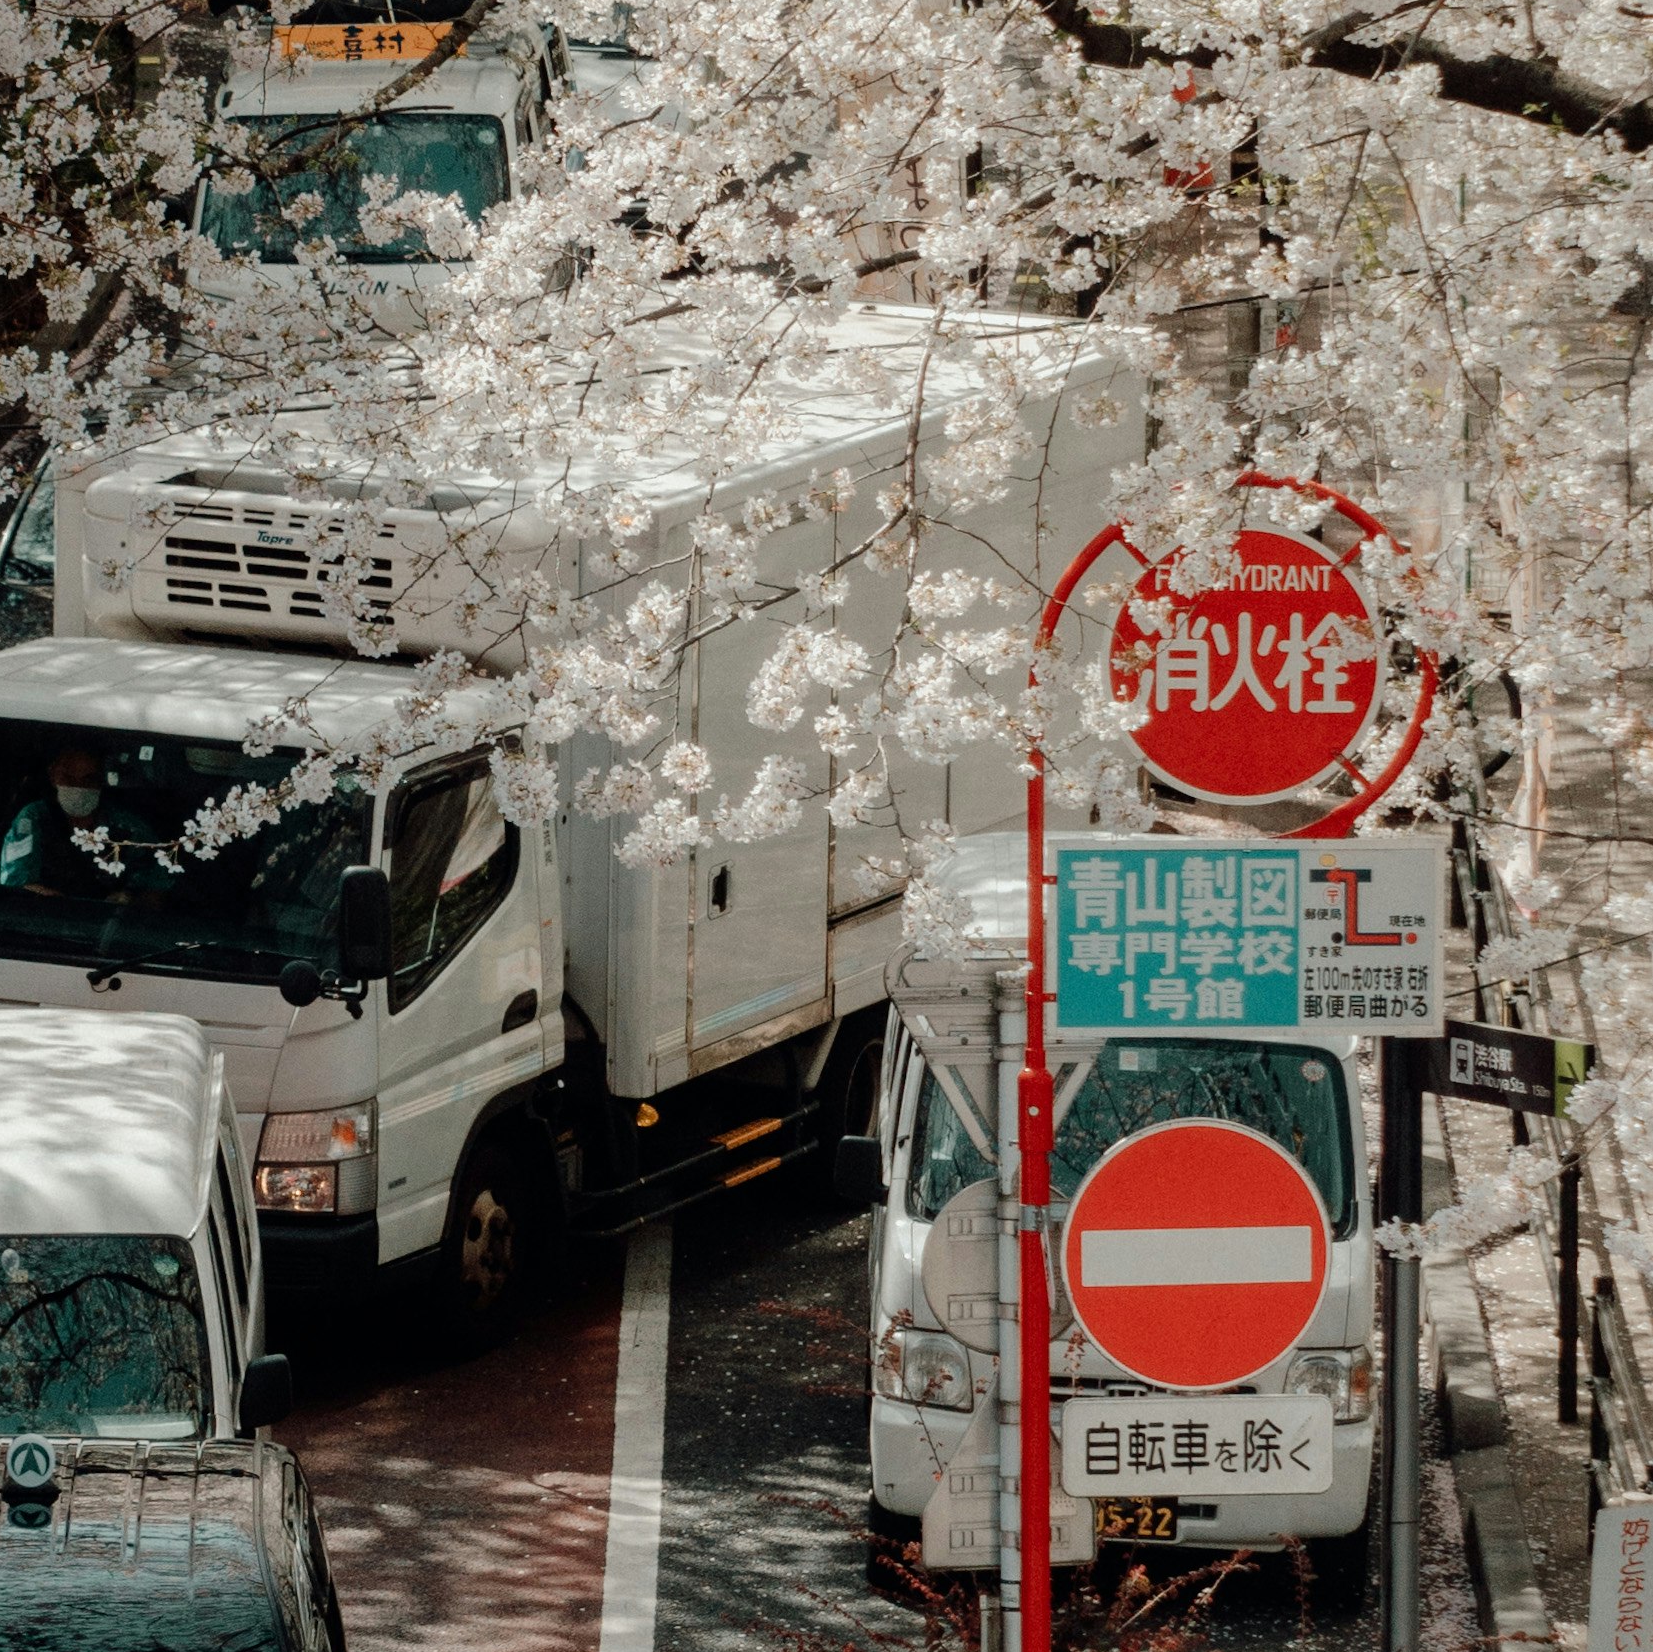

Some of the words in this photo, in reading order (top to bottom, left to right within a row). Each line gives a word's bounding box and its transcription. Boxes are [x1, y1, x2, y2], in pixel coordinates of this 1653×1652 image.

[257, 530, 294, 546] Topre
[1135, 611, 1356, 714] 消火栓
[1067, 855, 1296, 930] 青山製図
[1304, 908, 1343, 921] 郵便局
[1388, 915, 1427, 927] 現在地
[1067, 931, 1295, 977] 専門学校
[1306, 946, 1343, 958] すき家
[1118, 978, 1246, 1021] 1号館
[1304, 994, 1429, 1019] 郵便局曲がる
[1474, 1043, 1513, 1072] 渋谷駅
[1086, 1419, 1311, 1475] 自転車を除く
